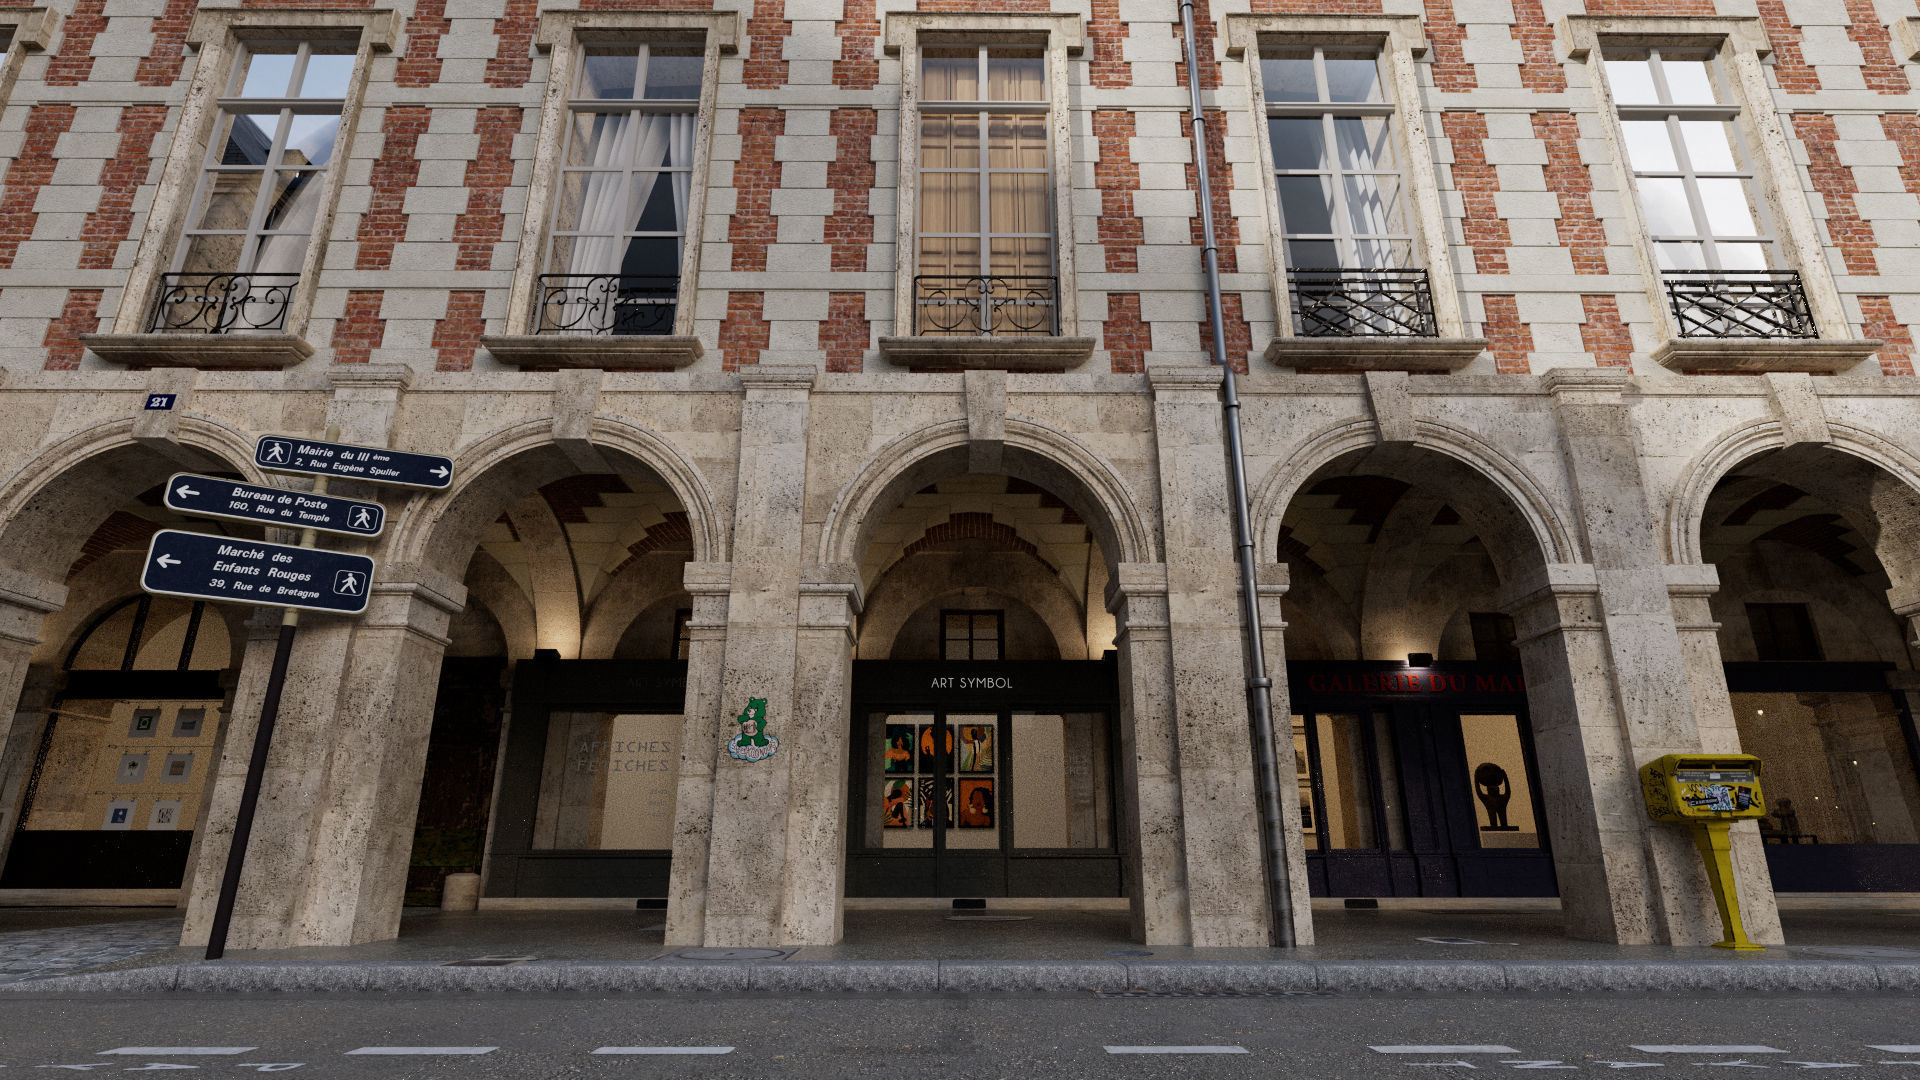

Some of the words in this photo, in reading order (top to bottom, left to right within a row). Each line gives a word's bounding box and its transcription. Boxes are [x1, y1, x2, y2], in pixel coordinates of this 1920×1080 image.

[150, 397, 168, 408] 21
[297, 444, 334, 457] Mairie
[340, 451, 354, 460] du
[357, 452, 370, 462] III
[373, 453, 390, 462] ème
[309, 459, 327, 469] Rue
[332, 461, 364, 474] Eugène
[369, 466, 401, 477] Spuller
[231, 486, 275, 502] Bureau
[277, 494, 292, 505] de
[295, 498, 328, 511] Poste
[255, 504, 275, 515] Rue
[280, 508, 293, 517] du
[299, 511, 330, 524] Temple
[217, 545, 265, 560] Marché
[271, 551, 293, 564] des
[212, 560, 260, 576] Enfants
[267, 566, 312, 582] Rouges
[233, 581, 253, 592] Rue
[259, 584, 272, 593] de
[277, 586, 320, 600] Bretagne
[931, 677, 955, 689] ART
[959, 677, 1013, 689] SYMBOL
[1308, 673, 1422, 693] GALERIE
[1428, 674, 1467, 693] DU
[580, 741, 671, 753] AFFICHES
